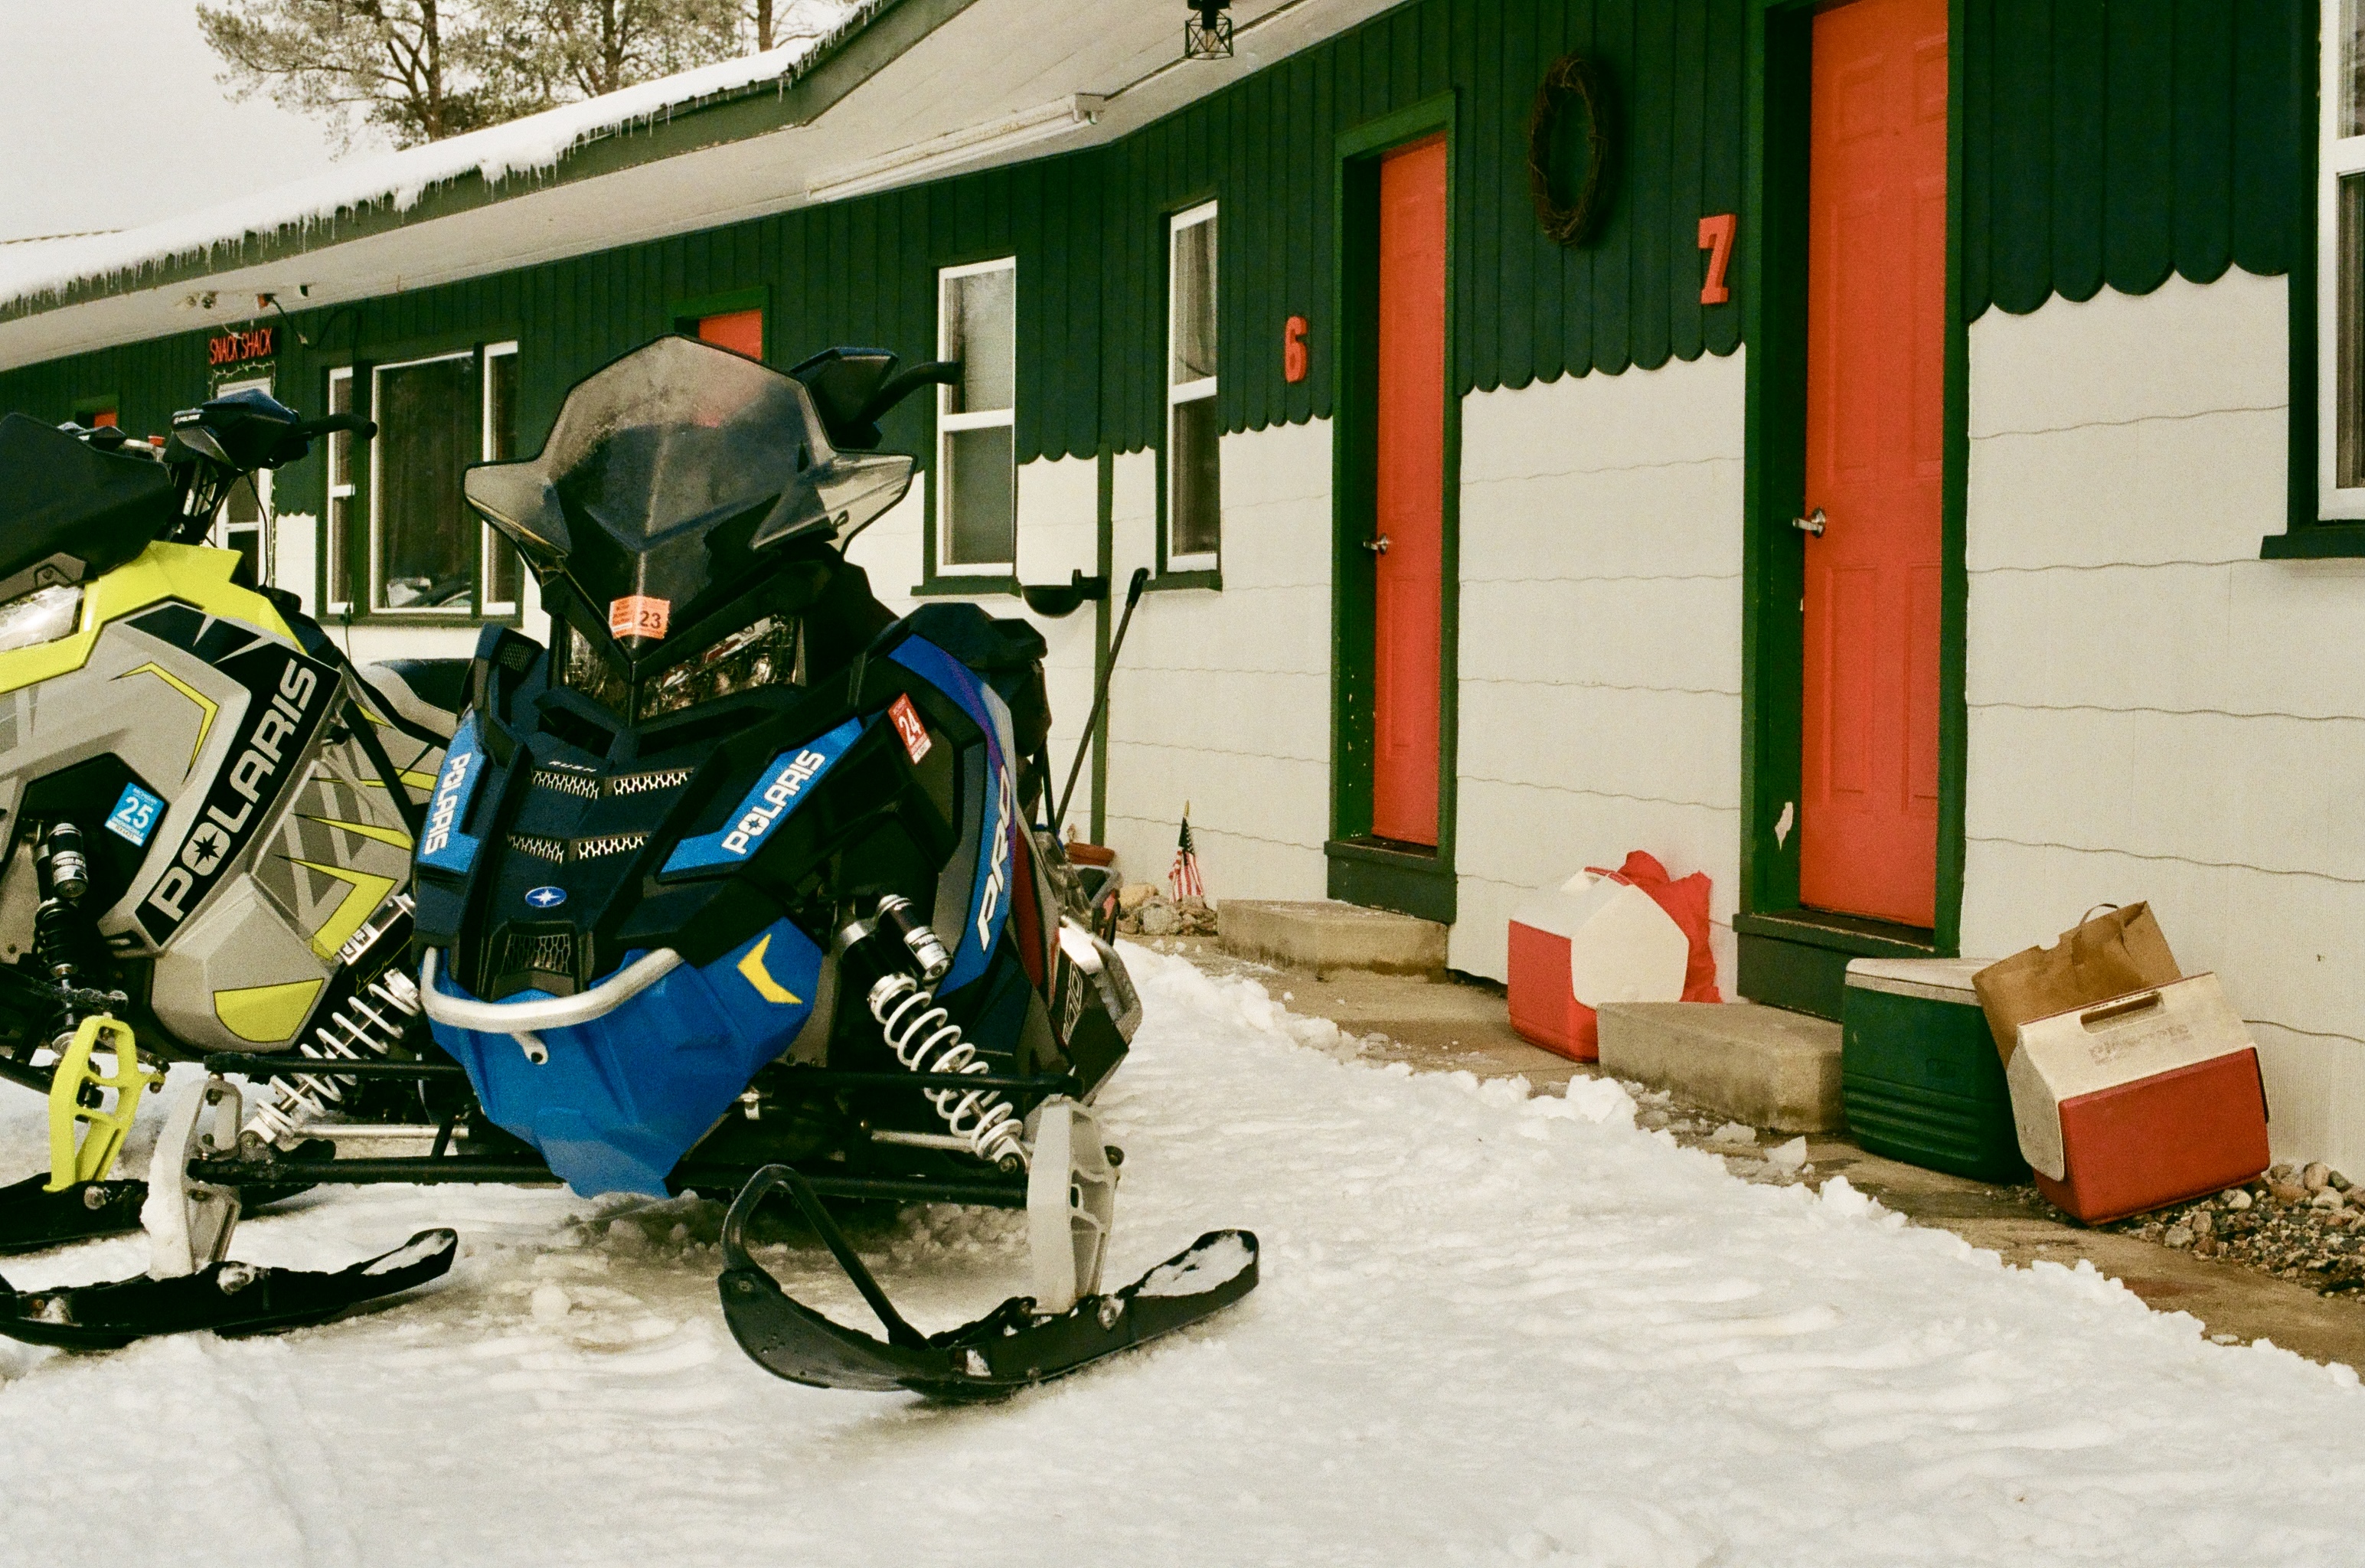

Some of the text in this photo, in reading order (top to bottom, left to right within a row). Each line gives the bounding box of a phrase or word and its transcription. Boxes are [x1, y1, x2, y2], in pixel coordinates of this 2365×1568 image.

[1699, 213, 1736, 305] 7
[209, 328, 273, 365] SNACK SHACK
[1285, 315, 1308, 383] 6
[639, 610, 661, 629] 23
[898, 707, 922, 746] 24
[147, 658, 318, 923] POLARIS
[548, 760, 597, 773] RUSH
[117, 795, 154, 829] 25
[423, 752, 472, 856] POLARIS
[721, 749, 826, 855] POLARIS
[978, 764, 1012, 952] PRO
